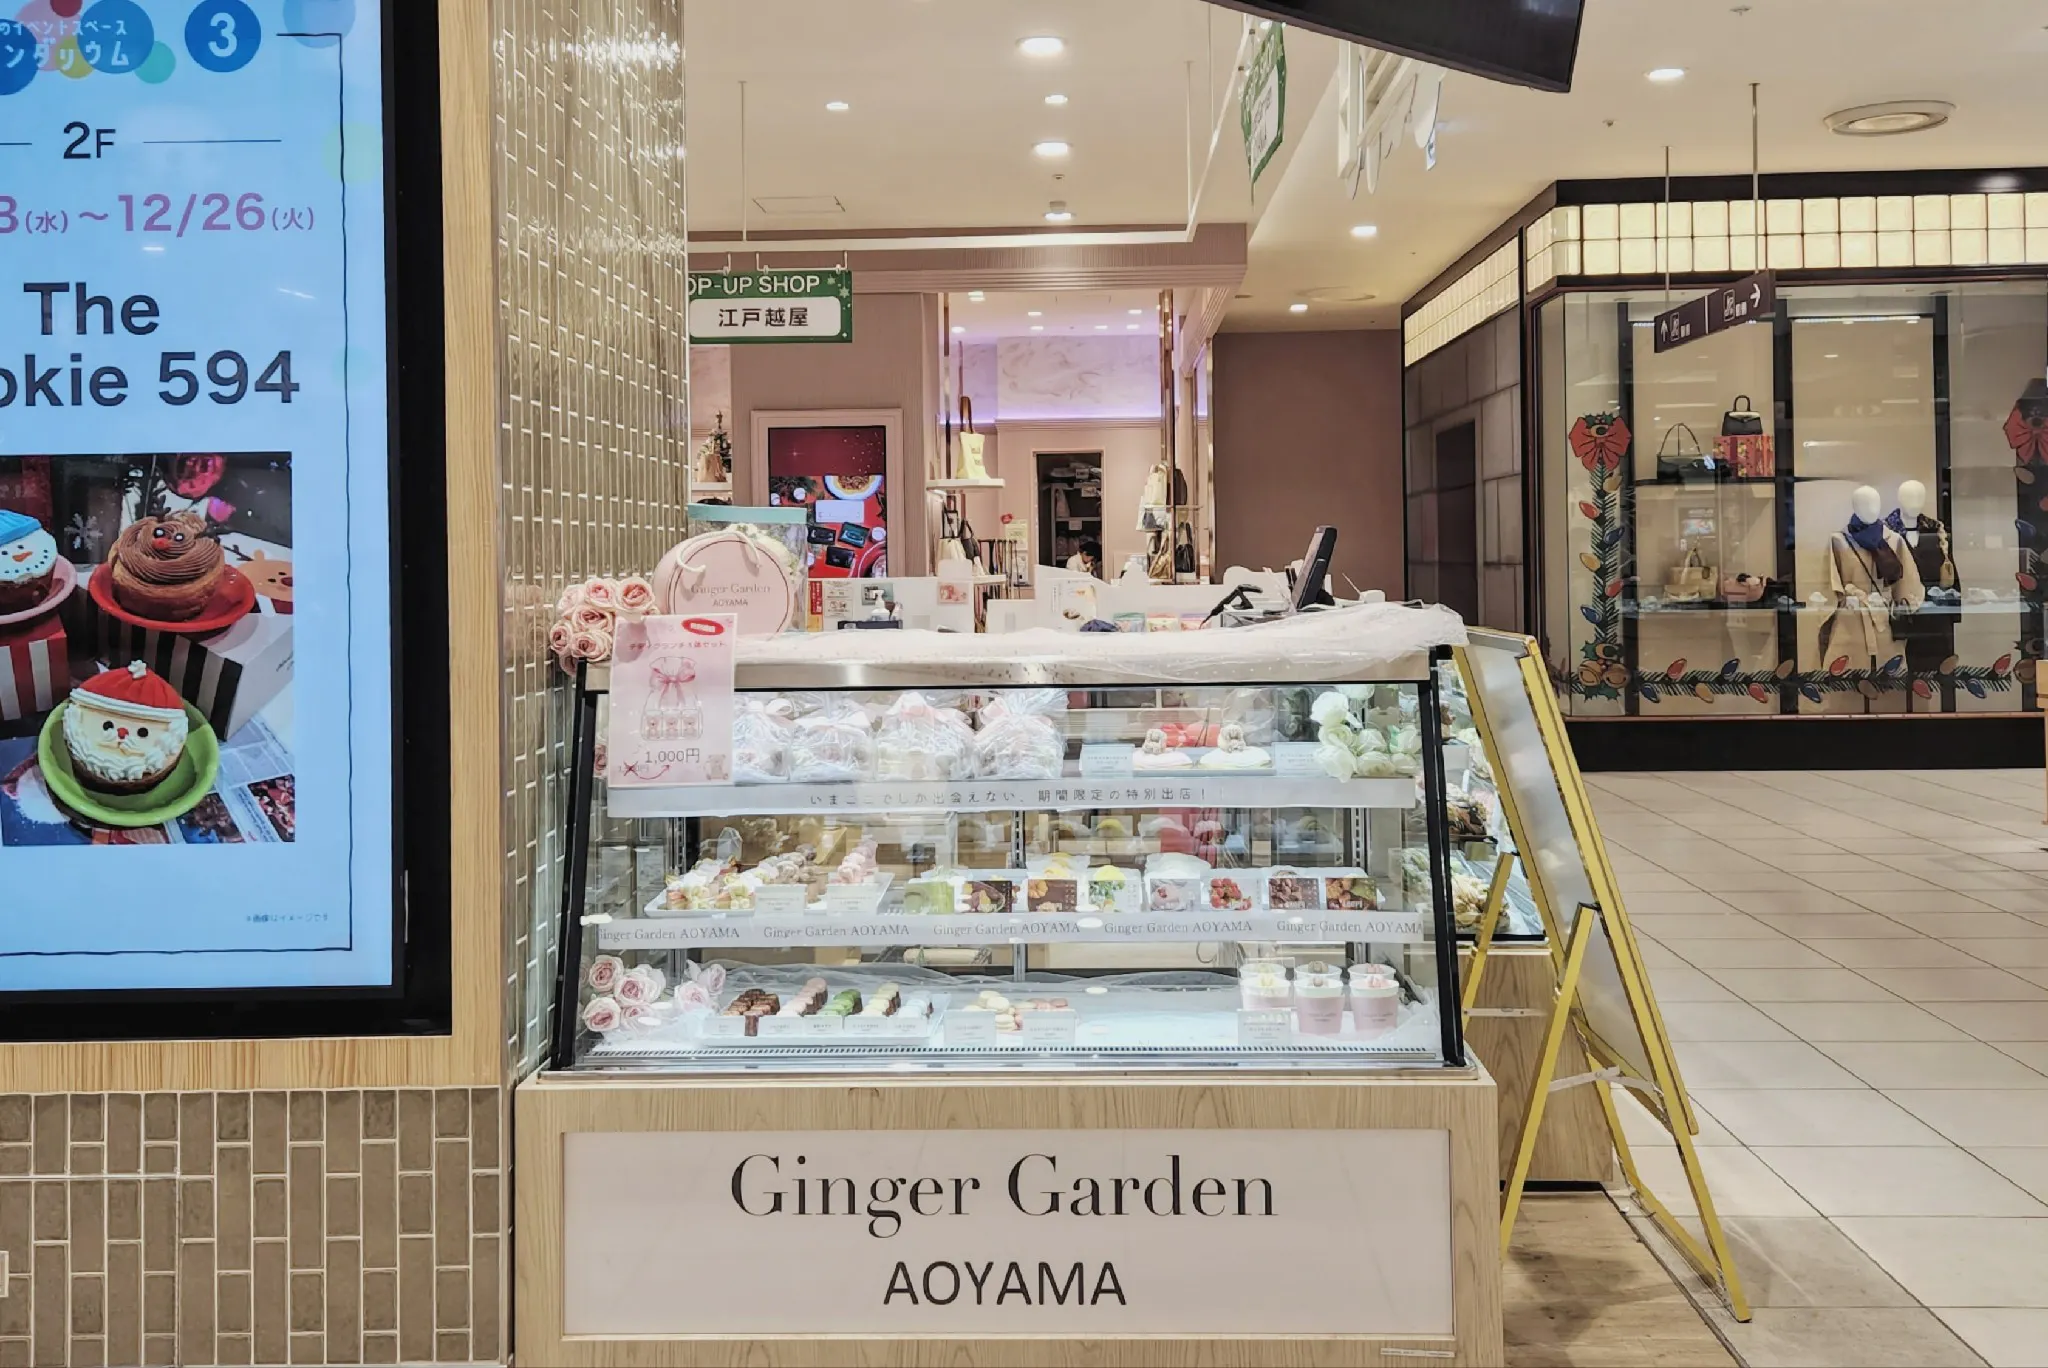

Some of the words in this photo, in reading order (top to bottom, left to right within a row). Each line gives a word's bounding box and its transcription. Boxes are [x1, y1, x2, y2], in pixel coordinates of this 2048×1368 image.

[207, 12, 237, 57] 3
[63, 121, 116, 160] 2F
[758, 275, 820, 293] SHOP
[23, 282, 160, 336] The
[718, 307, 808, 327] 江戸越屋
[158, 350, 300, 406] 594
[690, 584, 728, 597] Ginger
[730, 583, 771, 594] Garden
[712, 598, 749, 607] AOYAMA
[645, 748, 700, 764] 1,000円
[634, 927, 676, 940] Garden
[680, 927, 740, 939] AOYAMA
[763, 926, 801, 940] Ginger
[804, 925, 847, 938] Garden
[851, 924, 910, 937] AOYAMA
[933, 924, 971, 938] Ginger
[975, 922, 1016, 935] Garden
[1020, 921, 1081, 934] AOYAMA
[1104, 922, 1144, 936] Ginger
[1147, 921, 1188, 934] Garden
[1192, 920, 1252, 933] AOYAMA
[1276, 921, 1316, 935] Ginger
[1319, 920, 1361, 933] Garden
[731, 1153, 981, 1239] Ginger
[1008, 1153, 1279, 1217] Garden
[883, 1260, 1128, 1306] AOYAMA
